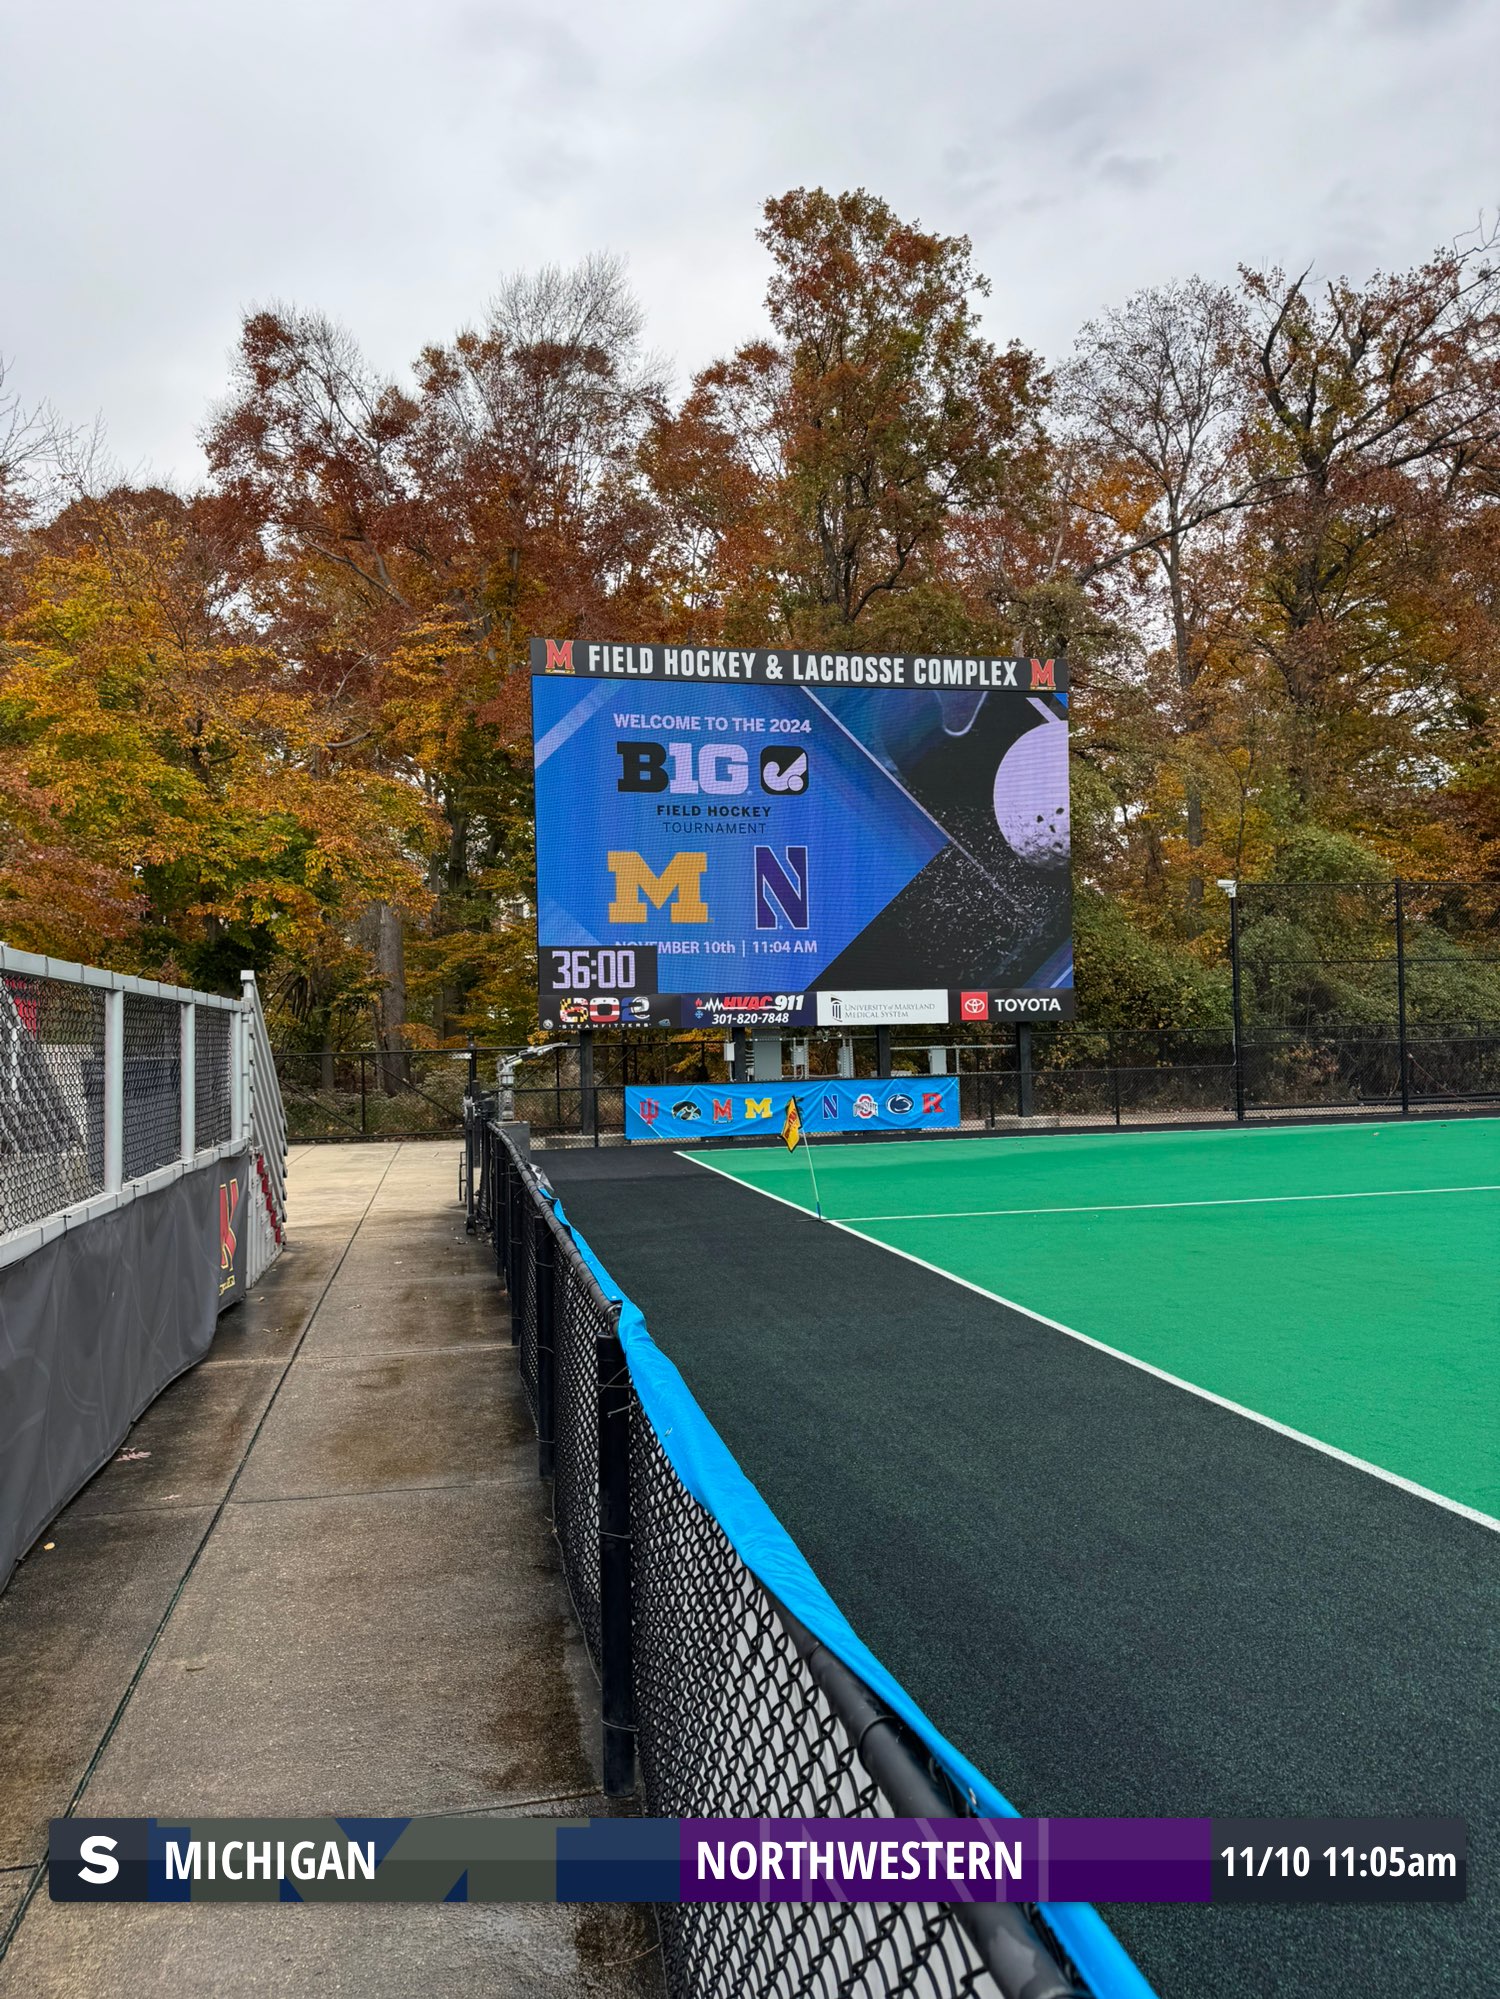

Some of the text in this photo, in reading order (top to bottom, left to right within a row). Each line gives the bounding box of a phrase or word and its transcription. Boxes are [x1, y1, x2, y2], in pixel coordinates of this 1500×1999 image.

[545, 639, 575, 670] M
[588, 645, 1018, 687] FIELD HOCKEY & LACROSSE COMPLEX
[1030, 658, 1056, 687] M
[613, 713, 812, 734] WELCOME TO THE 2024
[656, 805, 772, 818] FIELD HOCKEY
[663, 821, 767, 835] TOURNAMENT
[607, 851, 709, 924] M
[753, 845, 810, 930] N
[704, 940, 736, 954] 10th
[752, 940, 792, 954] 11:04
[793, 940, 818, 954] AM
[551, 949, 636, 989] 36:00
[723, 994, 805, 1011] HVAC 911
[844, 1003, 888, 1012] UNIVERSITY
[894, 1003, 936, 1011] MARYLAND
[994, 998, 1062, 1012] TOYOTA
[711, 1012, 790, 1025] 301-820-7848
[844, 1011, 880, 1019] MEDICAL
[712, 1098, 733, 1121] M
[744, 1097, 773, 1119] M
[822, 1094, 839, 1120] N
[921, 1092, 945, 1114] R
